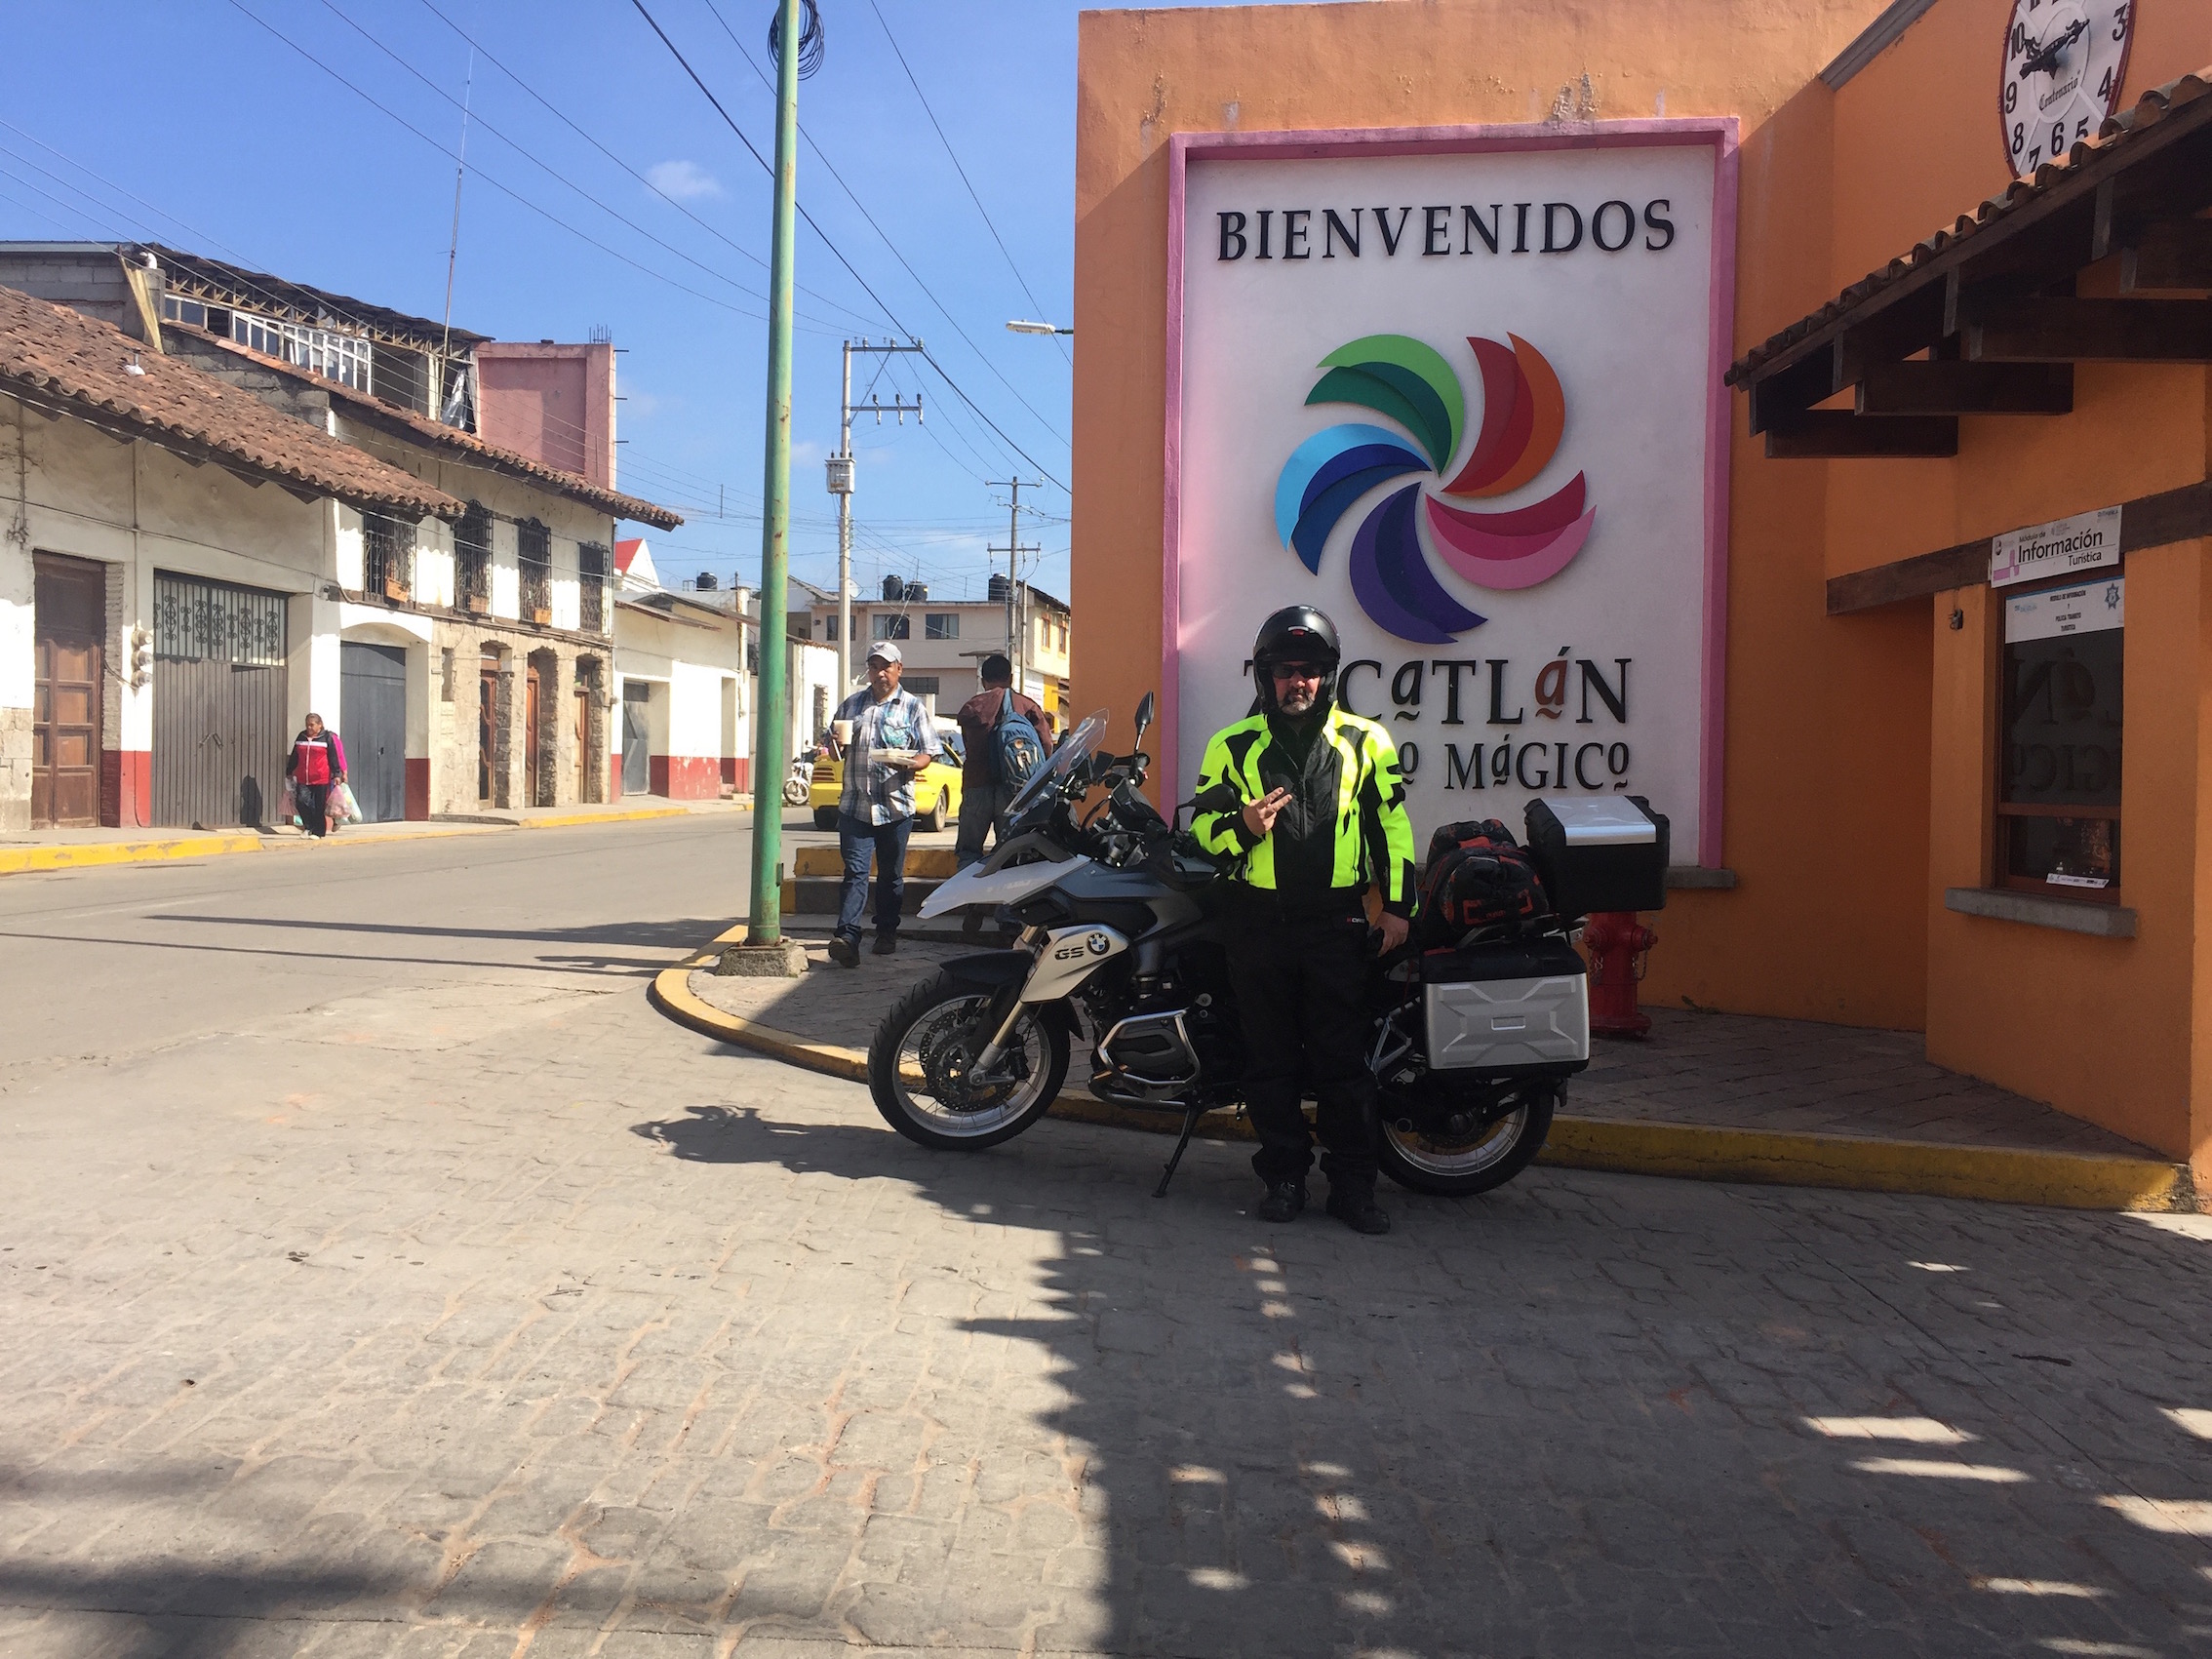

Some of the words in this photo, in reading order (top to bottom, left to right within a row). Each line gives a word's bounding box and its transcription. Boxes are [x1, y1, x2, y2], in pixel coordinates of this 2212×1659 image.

[2112, 3, 2127, 41] 3
[2011, 21, 2025, 60] 10
[2005, 81, 2017, 114] 9
[2098, 66, 2112, 102] 4
[2012, 122, 2024, 154] 8
[2051, 122, 2064, 155] 6
[2030, 145, 2041, 173] 7
[1217, 198, 1676, 261] BIENVENIDOS
[2018, 528, 2103, 563] Información
[2068, 552, 2102, 566] Turística
[1054, 946, 1085, 960] GS
